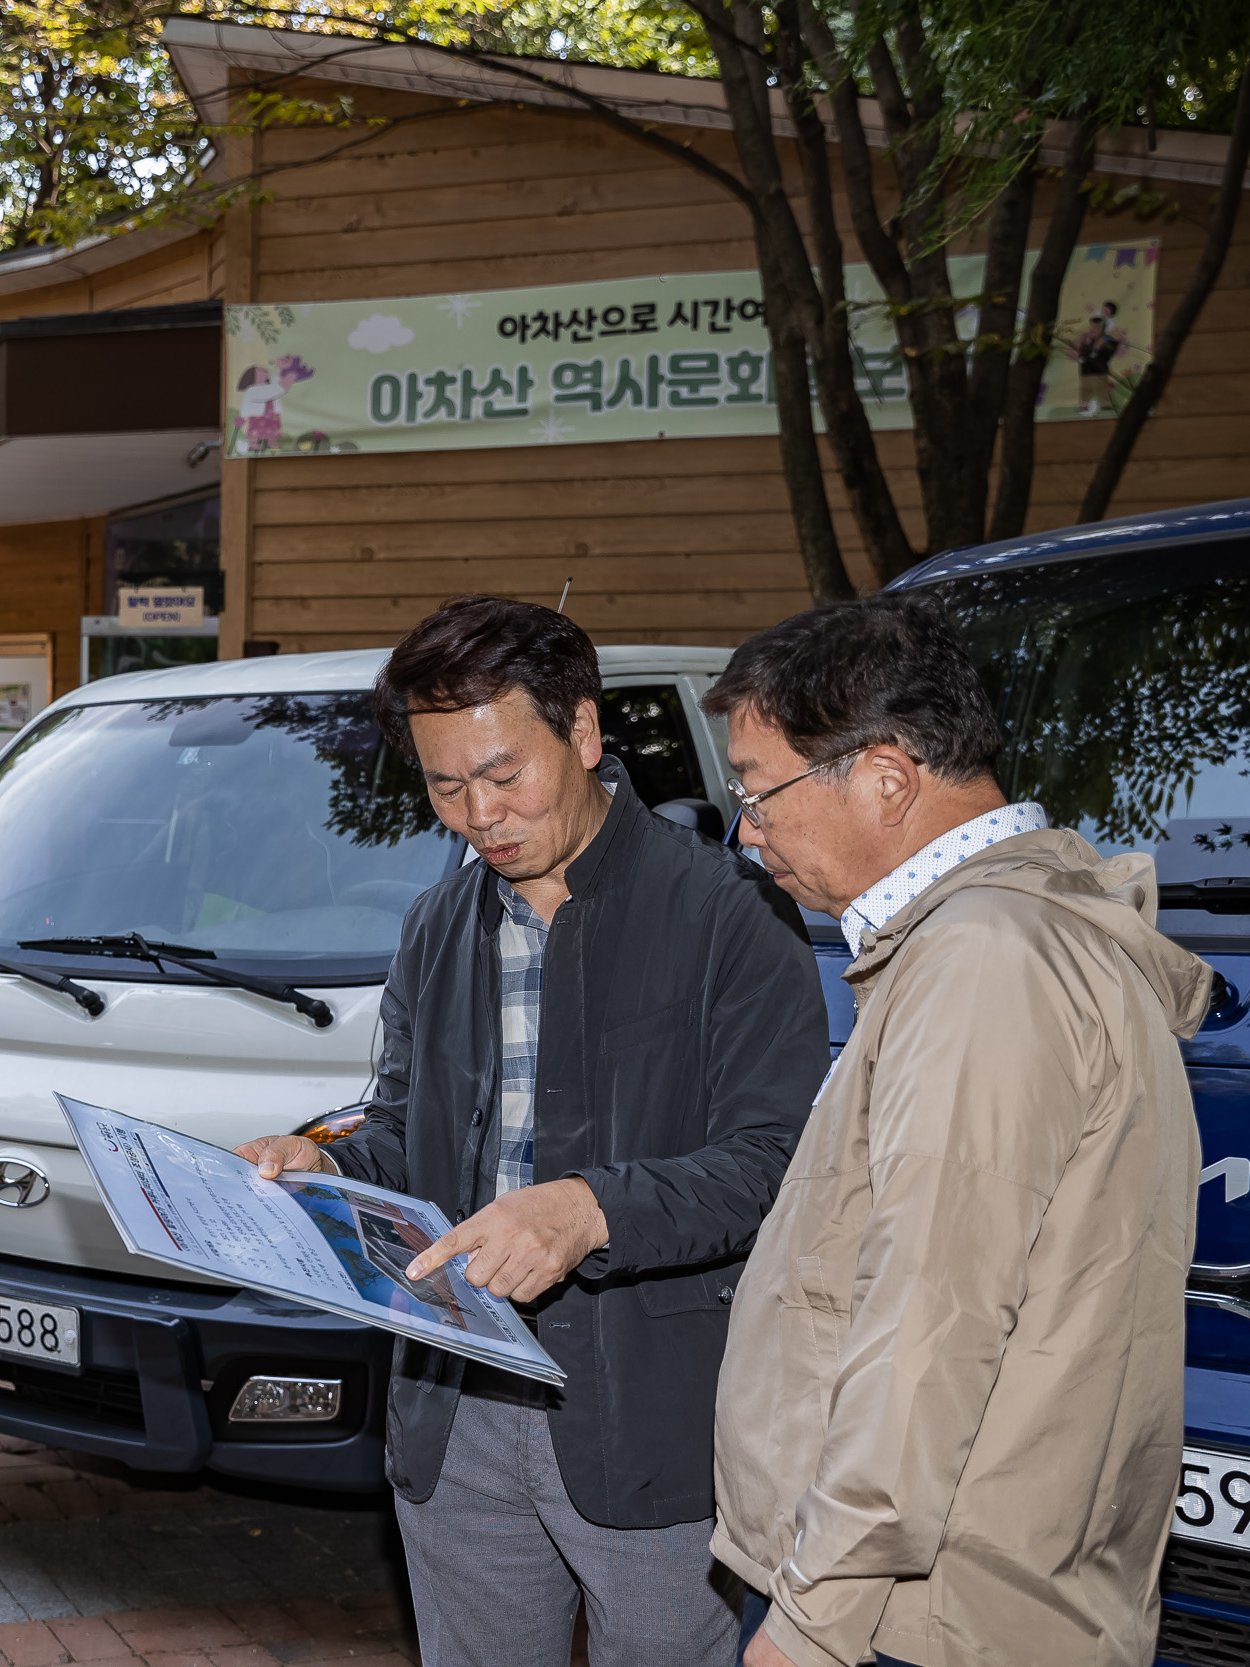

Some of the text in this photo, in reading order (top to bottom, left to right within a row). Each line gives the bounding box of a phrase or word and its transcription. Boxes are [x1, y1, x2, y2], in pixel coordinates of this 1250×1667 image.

[498, 297, 770, 345] 아차산으로 시간여
[369, 365, 534, 424] 아차산
